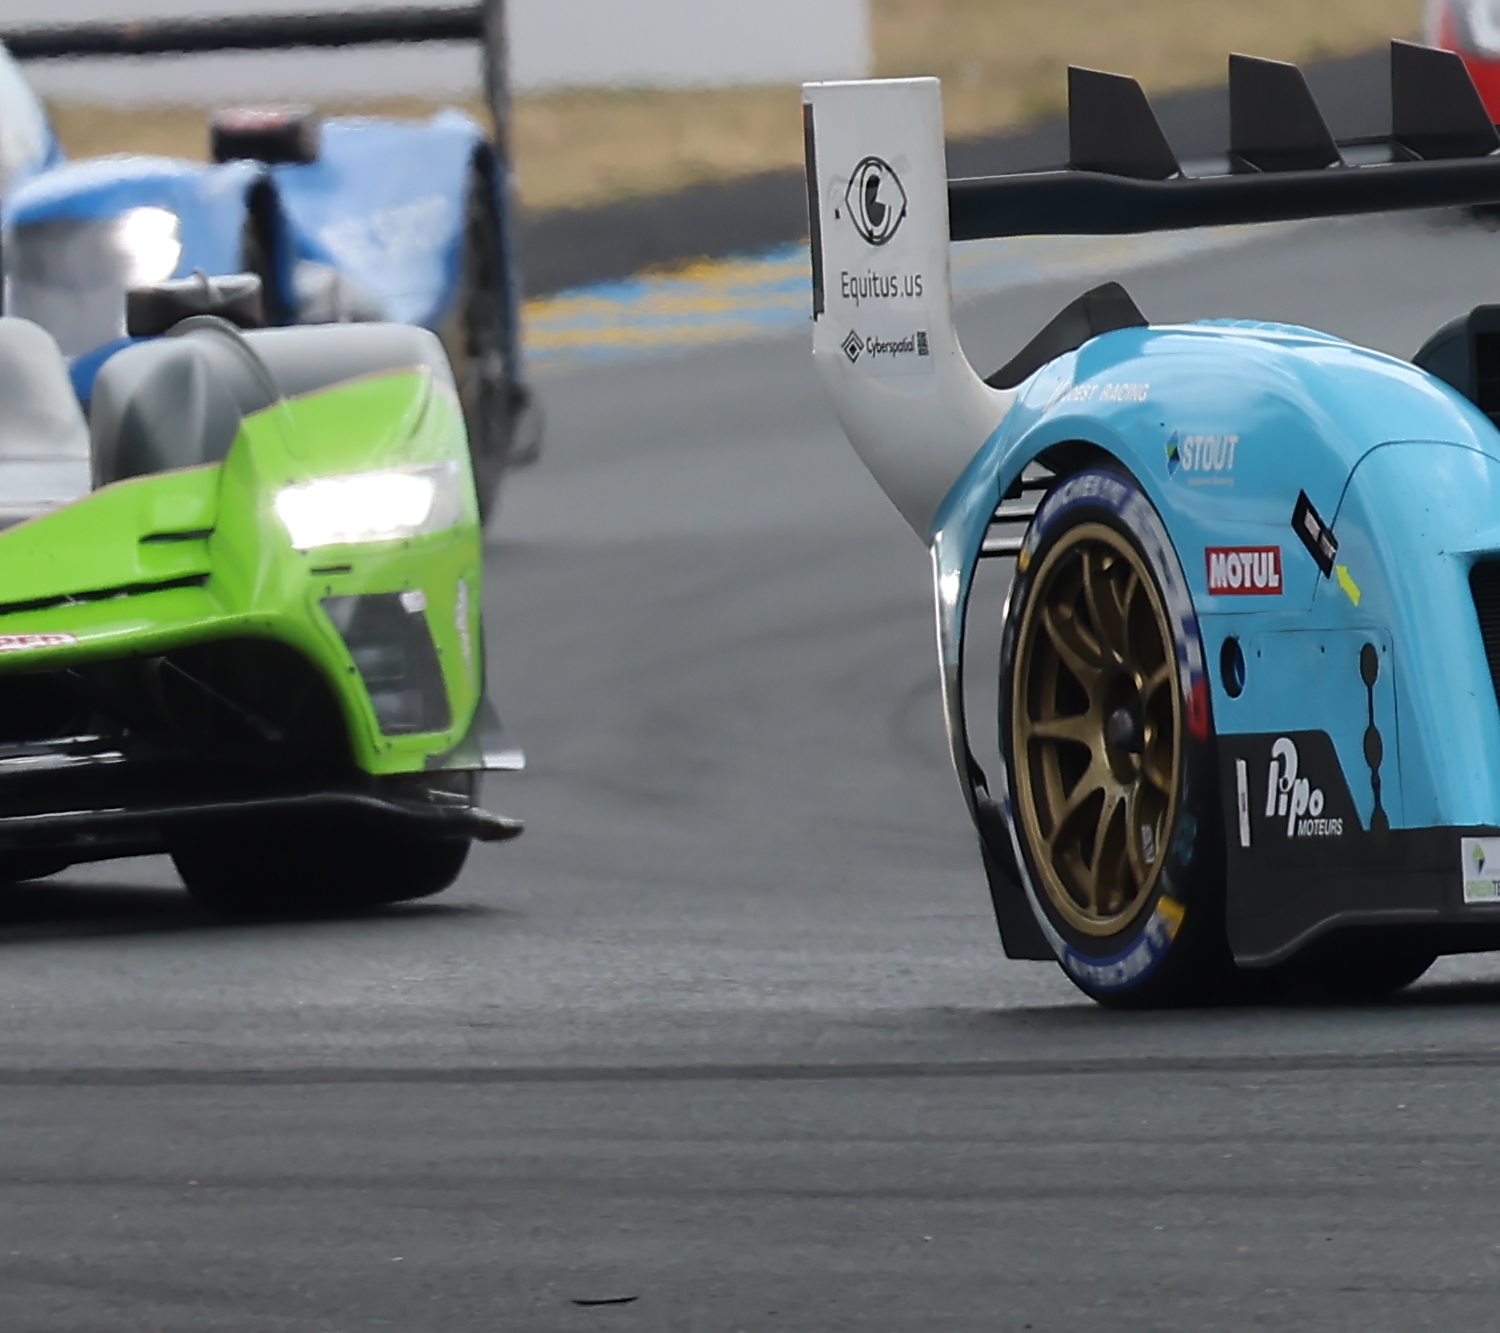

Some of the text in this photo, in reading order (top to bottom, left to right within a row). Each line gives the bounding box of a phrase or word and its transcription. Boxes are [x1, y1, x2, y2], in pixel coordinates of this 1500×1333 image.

[841, 269, 923, 307] Equitus.us
[1182, 434, 1240, 471] STOUT
[1208, 552, 1280, 589] MOTUL
[1265, 737, 1325, 838] Pipo
[1297, 818, 1343, 836] MOTEURS
